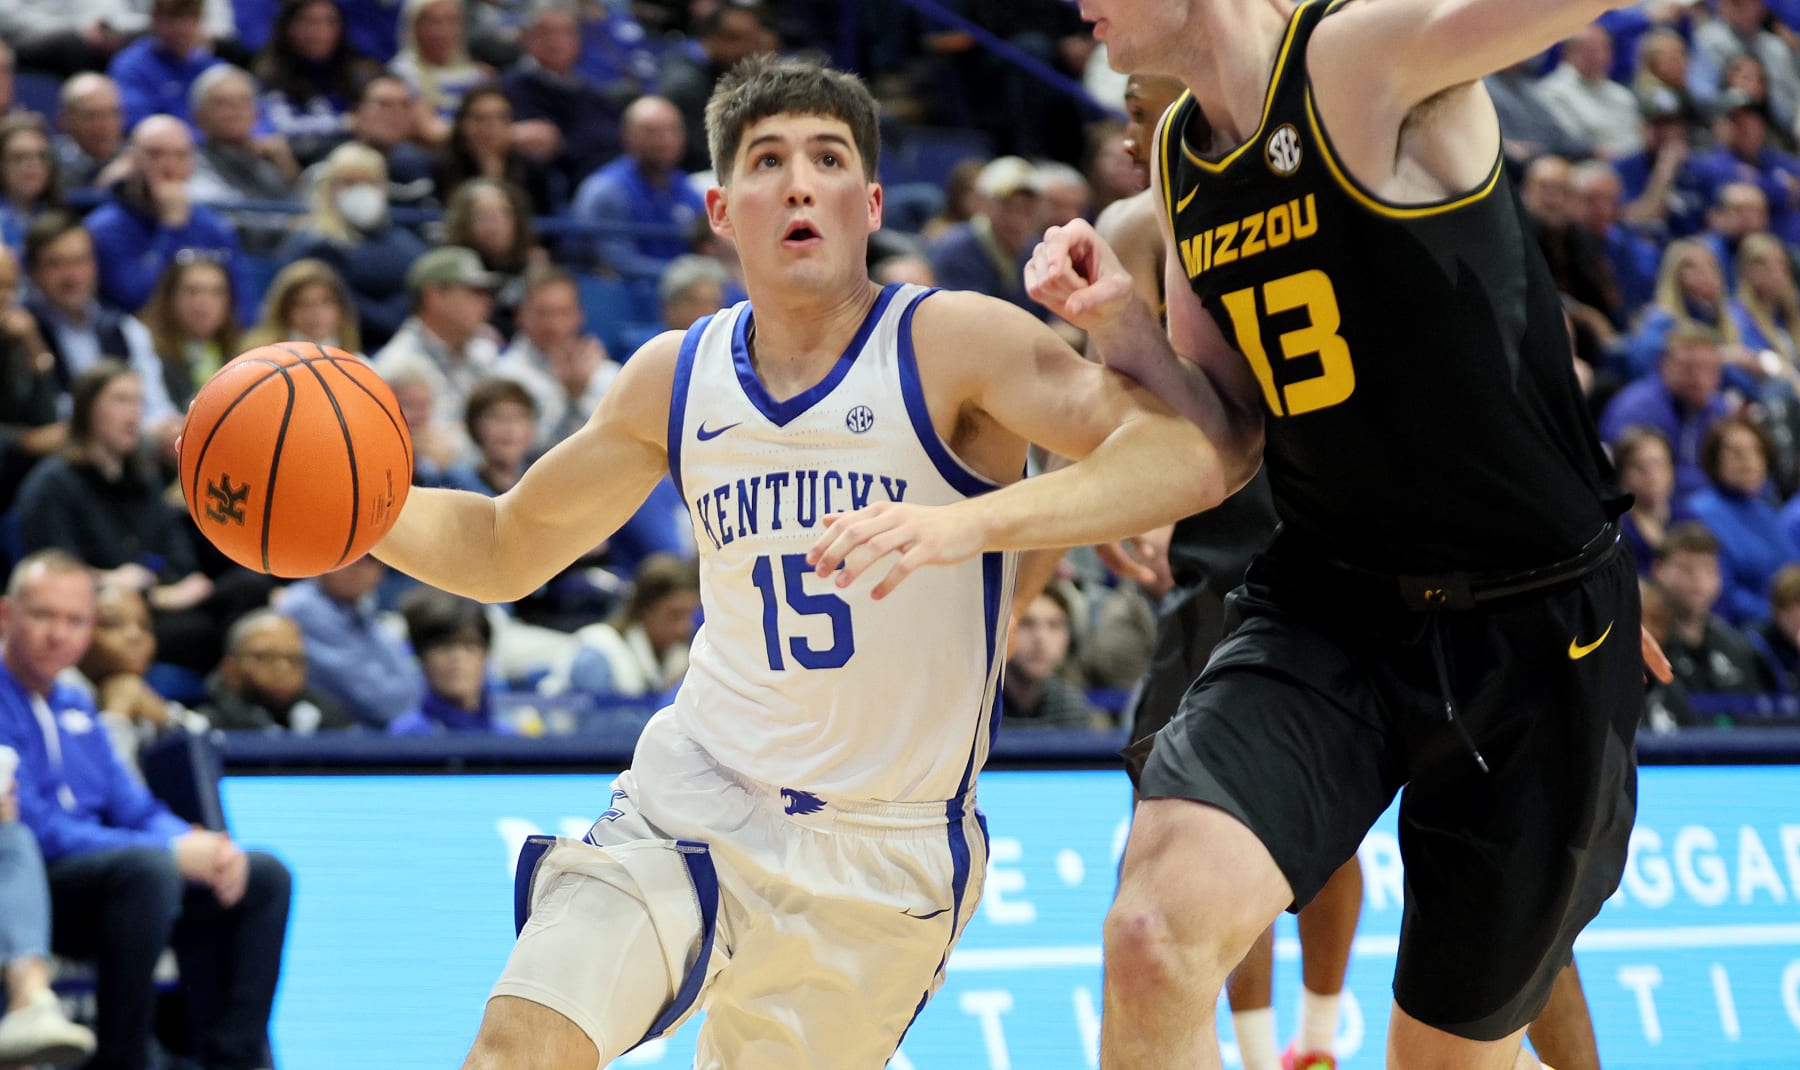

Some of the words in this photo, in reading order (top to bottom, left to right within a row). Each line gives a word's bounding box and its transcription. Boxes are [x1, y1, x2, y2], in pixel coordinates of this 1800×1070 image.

[1266, 125, 1301, 173] SEC
[1180, 193, 1318, 279] MIZZOU
[1221, 269, 1355, 417] 13
[847, 406, 873, 433] SEC
[752, 553, 855, 670] 15
